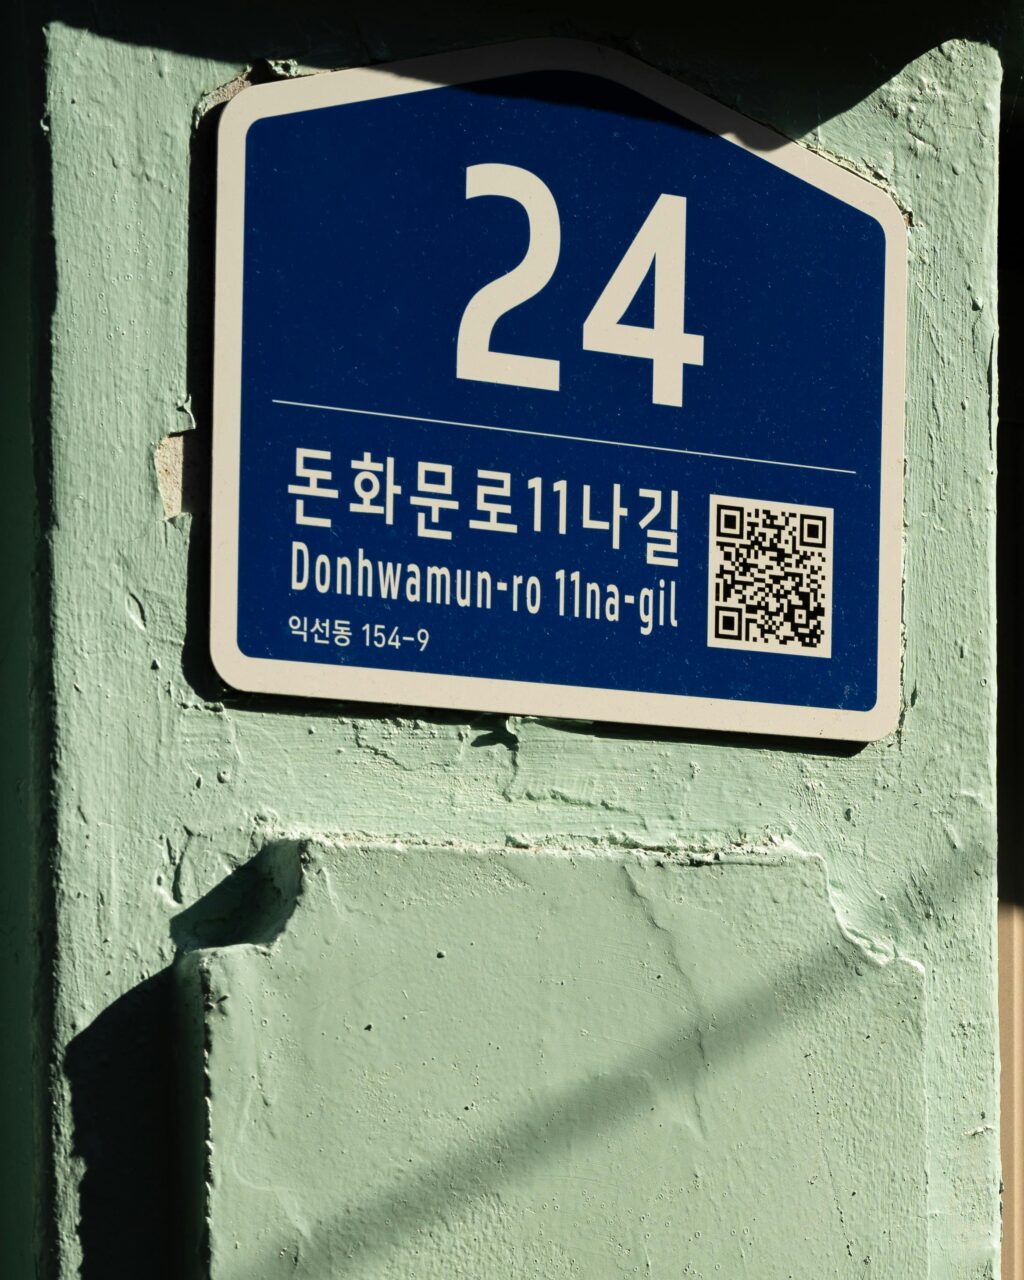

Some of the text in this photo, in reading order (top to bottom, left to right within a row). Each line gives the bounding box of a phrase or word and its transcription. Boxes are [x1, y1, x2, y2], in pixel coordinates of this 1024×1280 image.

[456, 162, 705, 408] 24
[287, 447, 679, 567] 돈화문로11나길
[288, 615, 430, 652] 익선동 154-9
[290, 541, 679, 636] Donhwamun-ro 11na-gil
